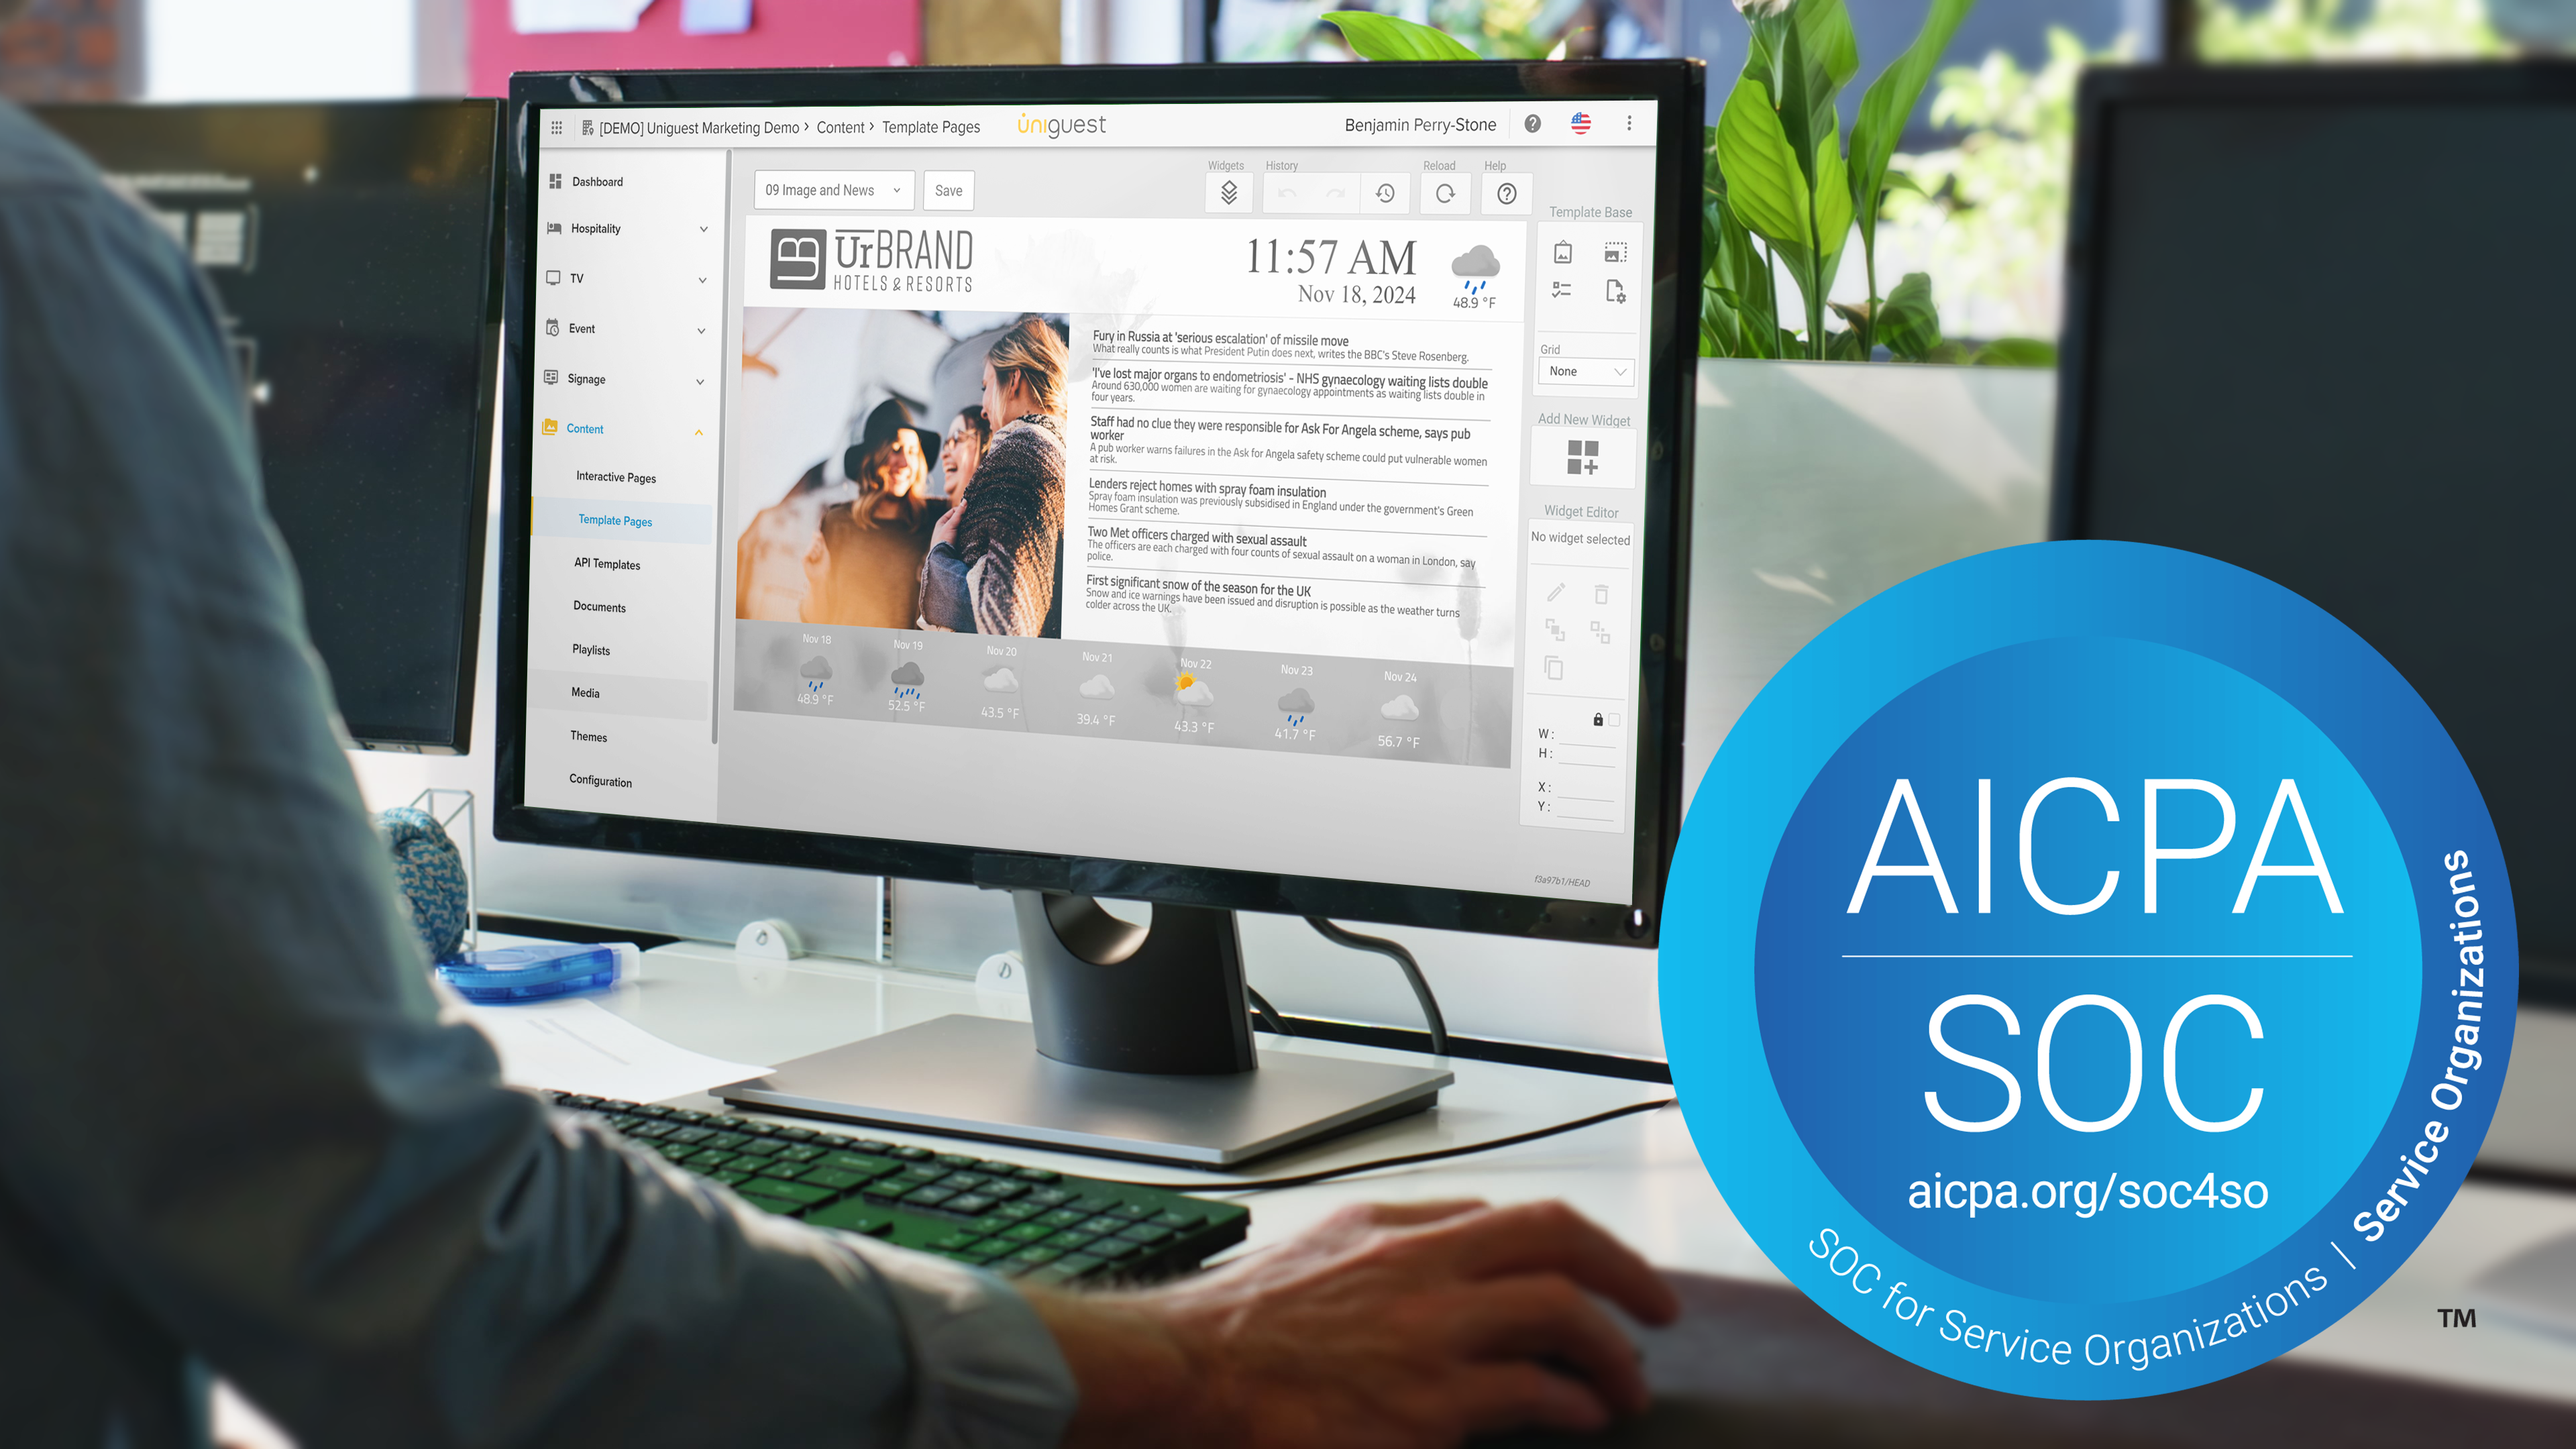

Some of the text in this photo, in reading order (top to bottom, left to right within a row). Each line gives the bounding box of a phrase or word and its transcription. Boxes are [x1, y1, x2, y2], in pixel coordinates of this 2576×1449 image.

[600, 121, 799, 137] [DEMO] Uniguest Marketing Demo
[818, 121, 865, 133] Content
[883, 121, 980, 136] Template Pages
[1346, 118, 1496, 135] Benjamin Perry-Stone
[1209, 160, 1244, 172] Widgets
[1267, 161, 1298, 172] History
[1424, 160, 1455, 170] Reload
[1485, 160, 1506, 173] Help
[573, 177, 623, 186] Dashboard
[766, 184, 874, 199] 09 Image and News
[936, 184, 962, 196] Save
[1550, 206, 1632, 220] Template Base
[572, 223, 621, 235] Hospitality
[1249, 239, 1417, 274] 11:57 AM
[571, 274, 584, 283] TV
[835, 275, 971, 292] HOTELS & RESORTS
[1299, 285, 1415, 306] Nov 18, 2024
[1454, 297, 1478, 308] 48.9
[570, 323, 594, 333] Event
[1094, 330, 1348, 346] Fury in Russia at 'serious escalation' of missile move
[1093, 343, 1115, 353] What
[1118, 344, 1139, 356] really
[1142, 345, 1169, 354] counts
[1181, 345, 1202, 355] what
[1205, 346, 1244, 356] President
[1248, 347, 1269, 356] Putin
[1272, 347, 1292, 357] does
[1295, 350, 1315, 359] next,
[1318, 350, 1345, 358] writes
[1348, 350, 1362, 359] the
[1364, 350, 1389, 360] BBC's
[1392, 351, 1416, 360] Steve
[1419, 352, 1468, 364] Rosenberg.
[1541, 345, 1560, 354] Grid
[1550, 366, 1576, 376] None
[568, 374, 605, 386] Signage
[1093, 368, 1111, 378] 'I've
[1114, 368, 1131, 378] lost
[1134, 369, 1162, 382] major
[1165, 372, 1197, 383] organs
[1200, 371, 1210, 381] to
[1213, 371, 1286, 383] endometriosis'
[1297, 373, 1319, 384] NHS
[1322, 374, 1385, 388] gynaecology
[1388, 376, 1426, 390] waiting
[1429, 376, 1450, 388] lists
[1453, 377, 1488, 388] double
[1538, 413, 1630, 428] Add New Widget
[568, 423, 603, 433] Content
[578, 470, 656, 485] Interactive Pages
[1545, 504, 1619, 519] Widget Editor
[579, 514, 652, 529] Template Pages
[1088, 526, 1307, 547] Two Met officers charged with sexual assault
[1532, 531, 1630, 545] No widget selected
[575, 557, 640, 571] API Templates
[1087, 574, 1311, 596] First significant snow of the season for the UK
[574, 600, 626, 612] Documents
[804, 634, 831, 644] Nov 18
[894, 639, 922, 650] Nov 19
[573, 644, 610, 656] Playlists
[987, 645, 1016, 656] Nov 20
[1083, 652, 1112, 662] Nov 21
[1181, 658, 1212, 669] Nov 22
[1282, 665, 1313, 676] Nov 23
[1385, 671, 1417, 682] Nov 24
[572, 687, 599, 698] Media
[798, 694, 818, 704] 48.9
[889, 700, 910, 711] 52.5
[981, 707, 1003, 718] 43.5
[1077, 714, 1099, 724] 39.4
[1175, 721, 1197, 733] 43.3
[571, 731, 607, 742] Themes
[1275, 728, 1299, 739] 41.7
[1379, 735, 1402, 747] 56.7
[570, 773, 631, 788] Configuration
